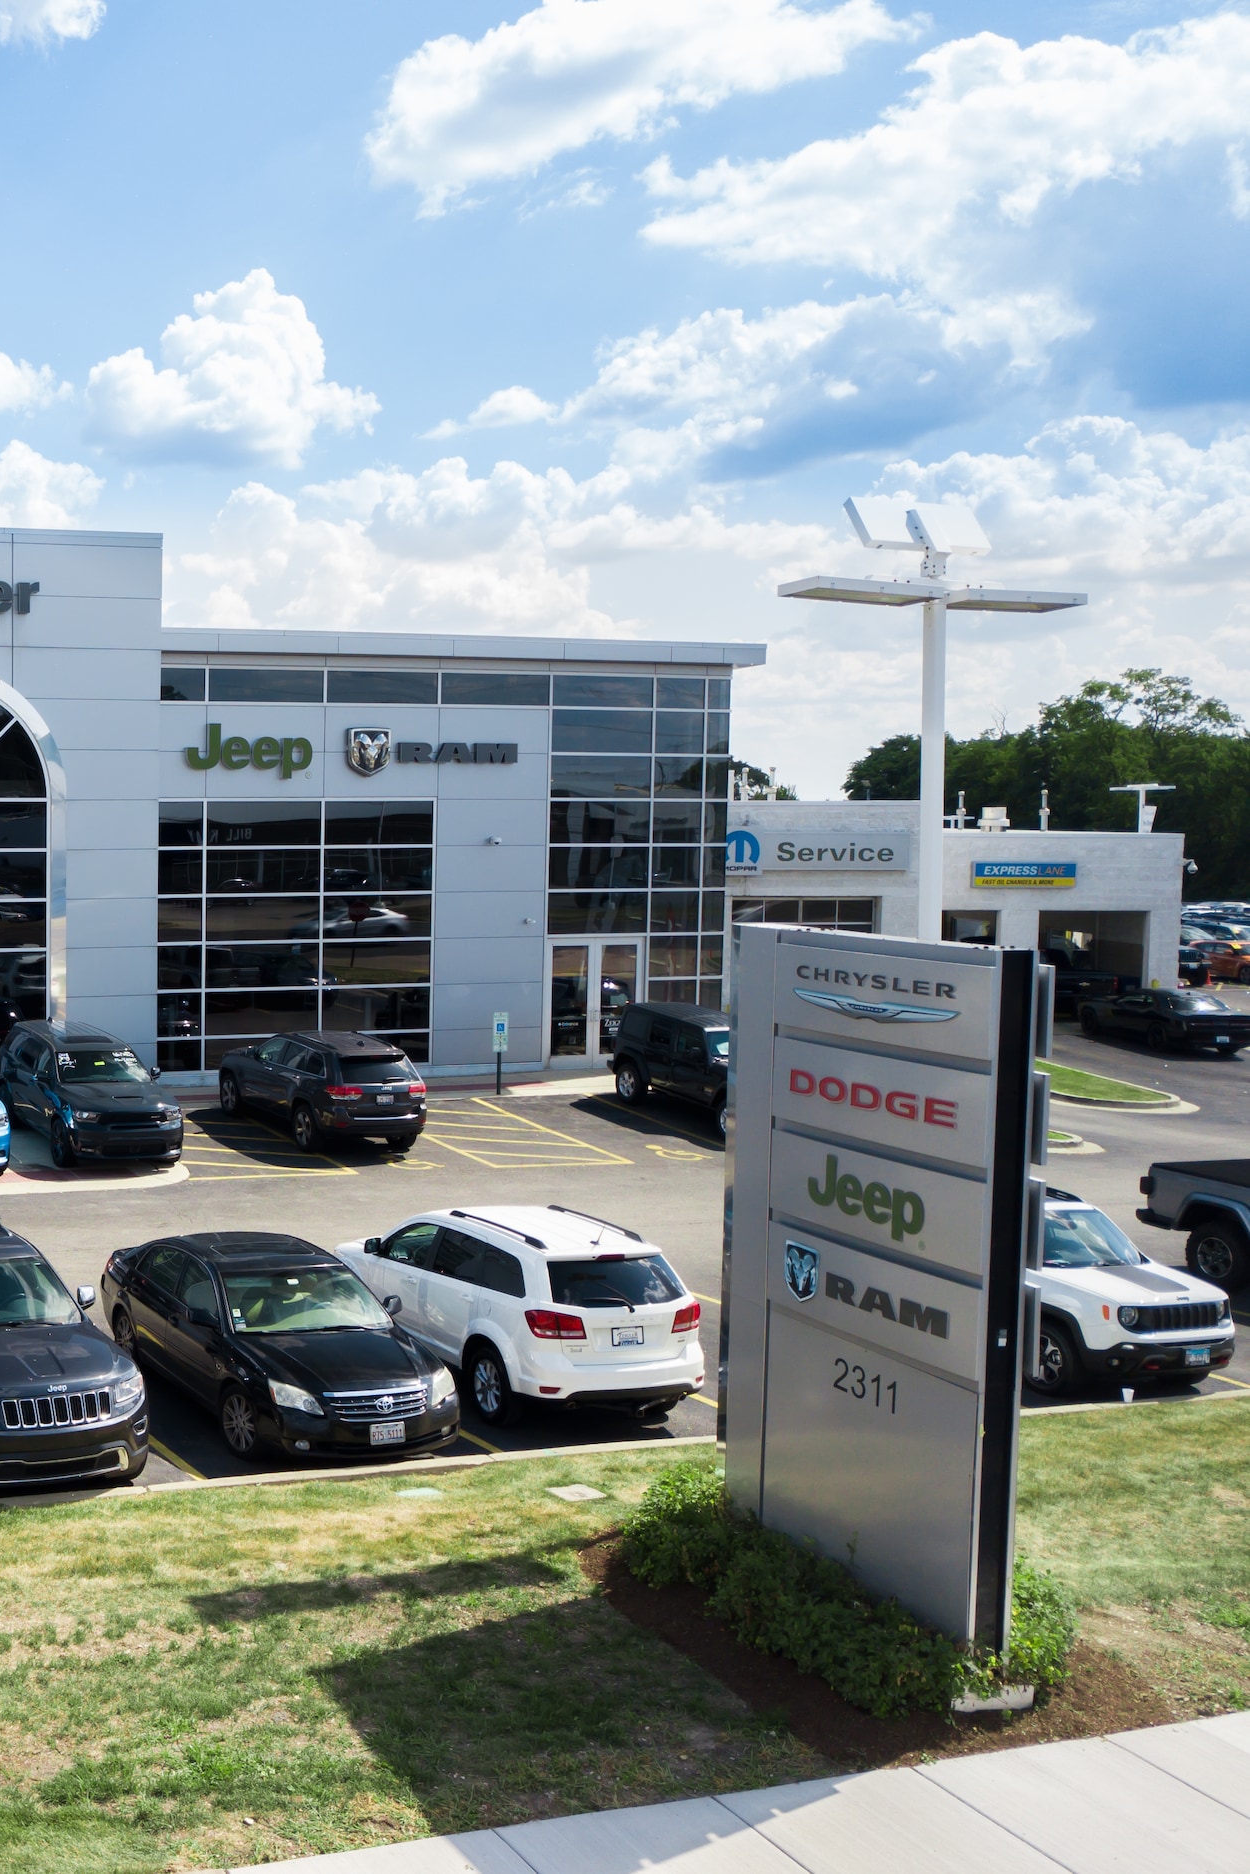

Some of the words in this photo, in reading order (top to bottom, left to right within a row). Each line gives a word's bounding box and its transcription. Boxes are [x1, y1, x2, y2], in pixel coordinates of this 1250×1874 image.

[184, 723, 313, 779] Jeep
[397, 742, 519, 764] RAM
[777, 842, 894, 862] Service
[796, 965, 957, 999] CHRYSLER
[789, 1068, 958, 1129] DODGE
[807, 1153, 925, 1242] Jeep
[825, 1271, 949, 1340] RAM
[47, 1384, 68, 1393] Jeep
[833, 1357, 898, 1415] 2311
